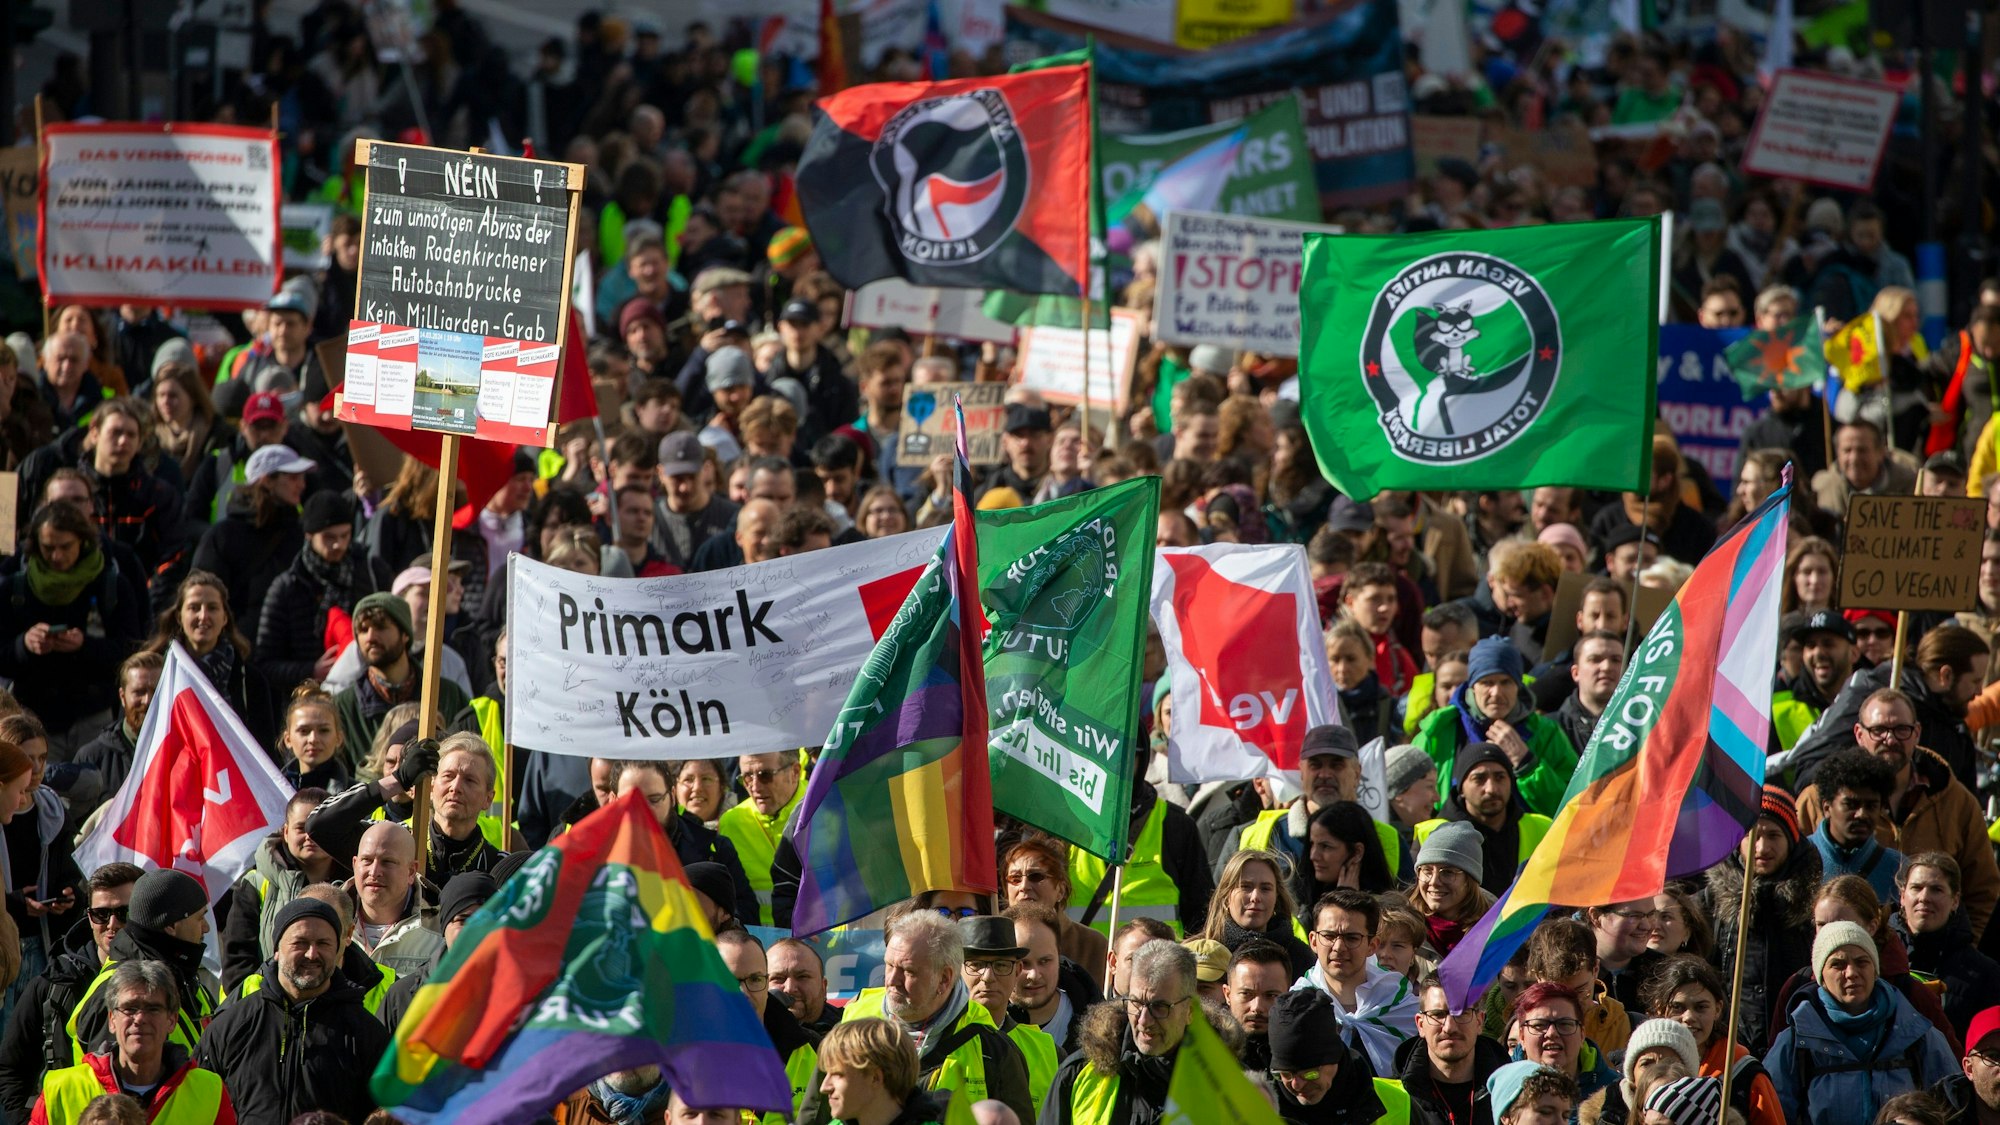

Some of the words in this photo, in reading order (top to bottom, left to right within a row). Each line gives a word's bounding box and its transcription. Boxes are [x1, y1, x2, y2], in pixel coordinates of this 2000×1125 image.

[444, 161, 498, 199] NEIN
[373, 207, 402, 226] zum
[408, 207, 473, 237] unnötigen
[478, 206, 522, 241] Abriss
[525, 213, 552, 245] der
[370, 234, 416, 260] intakten
[425, 235, 547, 273] Rodenkirchener
[391, 266, 521, 303] Autobahnbrücke
[365, 300, 396, 325] Kein
[1856, 500, 1902, 529] SAVE
[1912, 502, 1945, 530] THE
[1871, 537, 1943, 560] CLIMATE
[1953, 539, 1967, 559] &
[1852, 570, 1884, 598] GO
[1895, 571, 1957, 598] VEGAN
[559, 588, 784, 656] Primark
[615, 688, 730, 738] Köln
